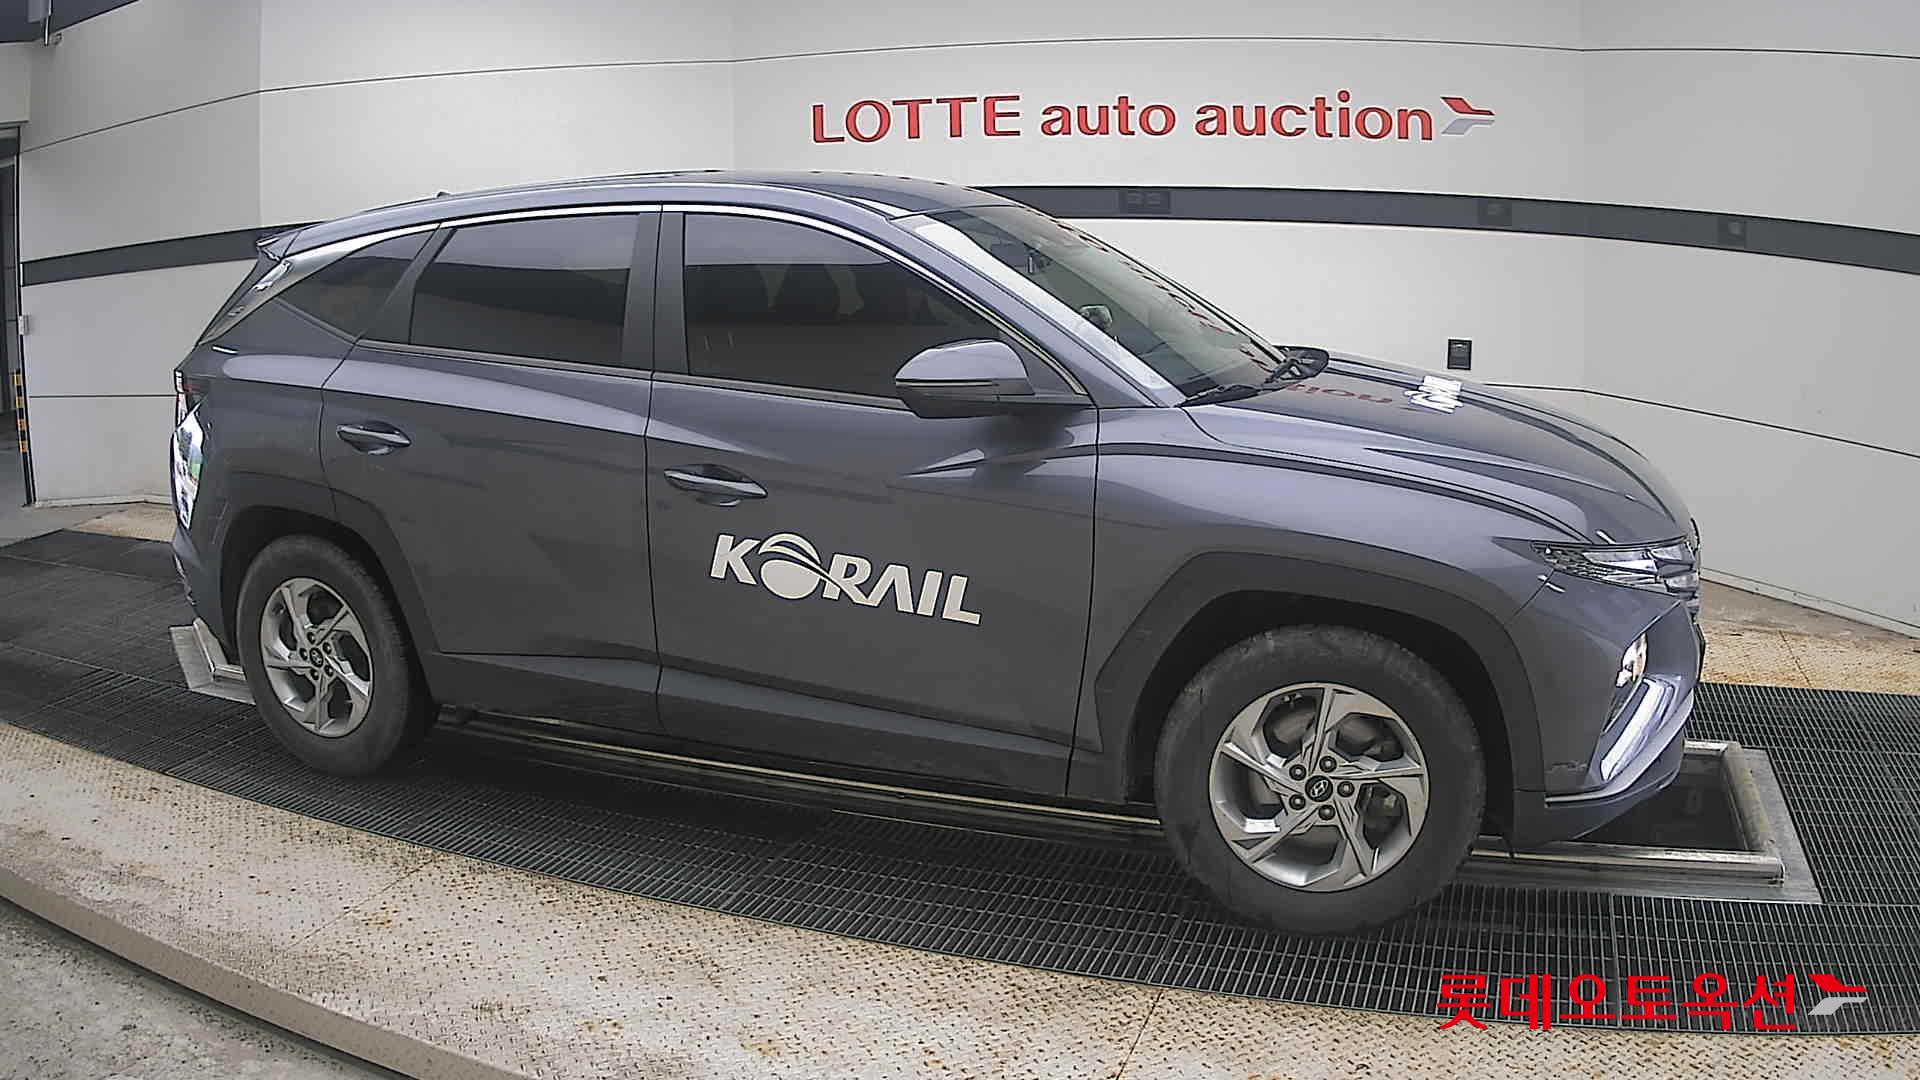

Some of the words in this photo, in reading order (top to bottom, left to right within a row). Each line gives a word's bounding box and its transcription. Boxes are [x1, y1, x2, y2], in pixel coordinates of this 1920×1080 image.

[812, 95, 1020, 143] LOTTE
[1041, 96, 1176, 136] auto
[1195, 90, 1434, 141] auction
[710, 532, 981, 626] KORAIL
